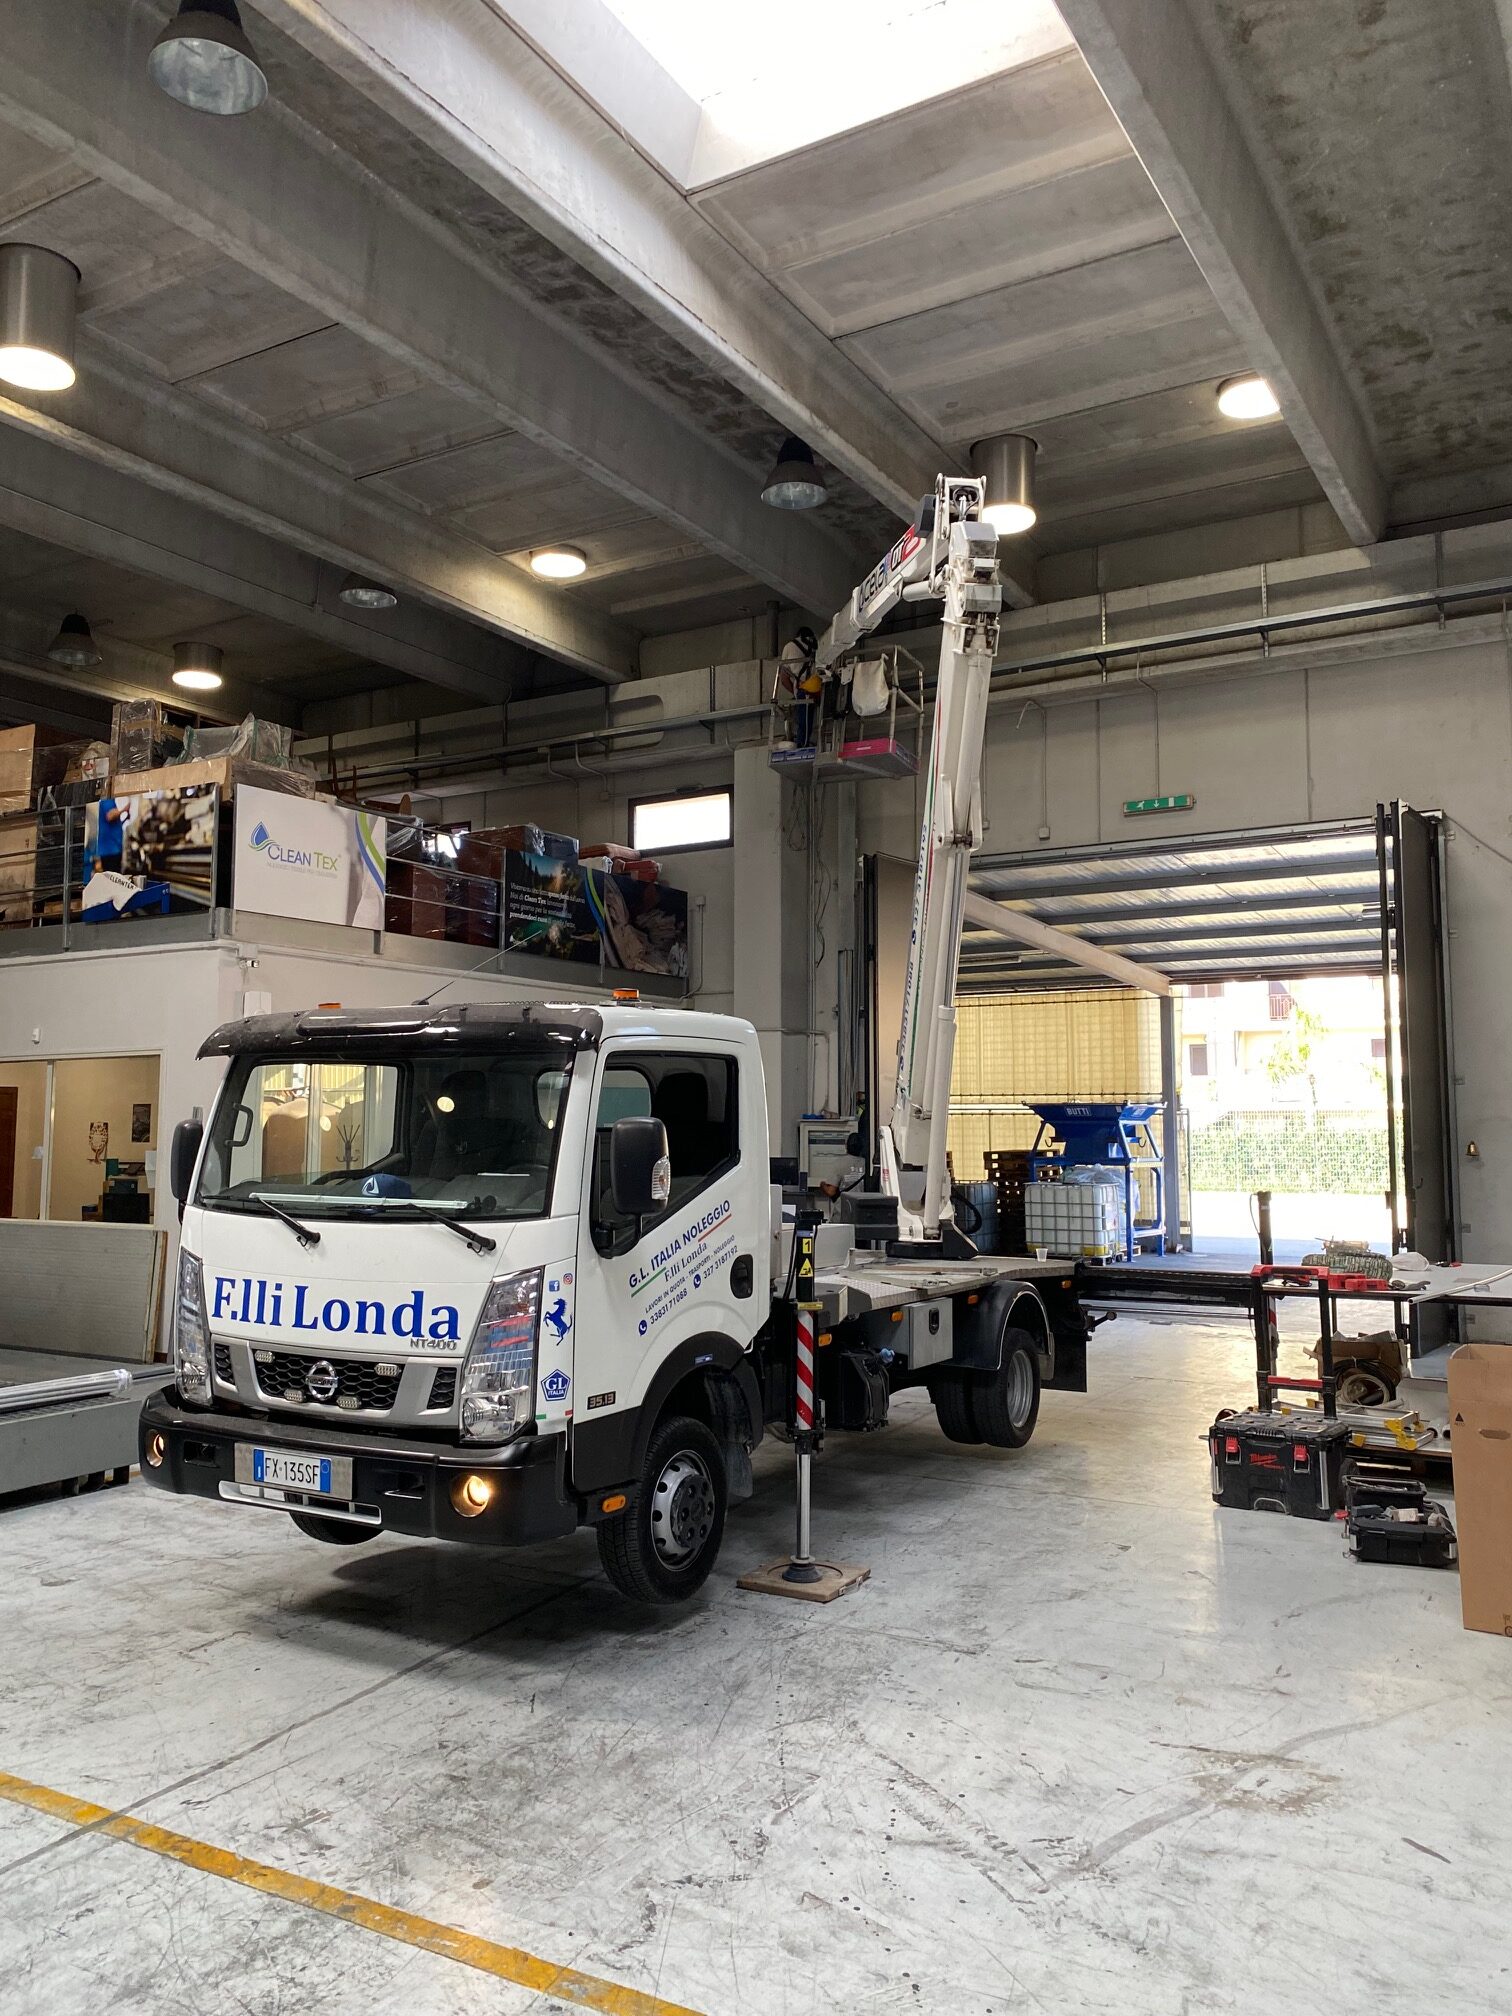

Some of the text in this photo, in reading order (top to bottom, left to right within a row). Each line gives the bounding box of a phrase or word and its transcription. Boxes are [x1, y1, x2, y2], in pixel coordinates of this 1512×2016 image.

[268, 844, 312, 867] CLEAN
[314, 852, 338, 871] TEX
[1066, 1107, 1090, 1116] BUTTI
[629, 1200, 730, 1288] G.L. ITALIA NOLEGGIO
[681, 1242, 707, 1268] Londa
[804, 1240, 810, 1252] 1
[645, 1295, 662, 1314] LAVORI
[669, 1276, 686, 1293] QUOTA
[688, 1255, 711, 1276] TRASPORTI
[713, 1235, 735, 1256] NOLEGGIO
[703, 1265, 714, 1279] 327
[715, 1245, 738, 1270] 3187192
[211, 1276, 461, 1341] F.lli Londa
[410, 1338, 457, 1350] NT400
[545, 1377, 567, 1391] GL
[589, 1393, 614, 1408] 35.13
